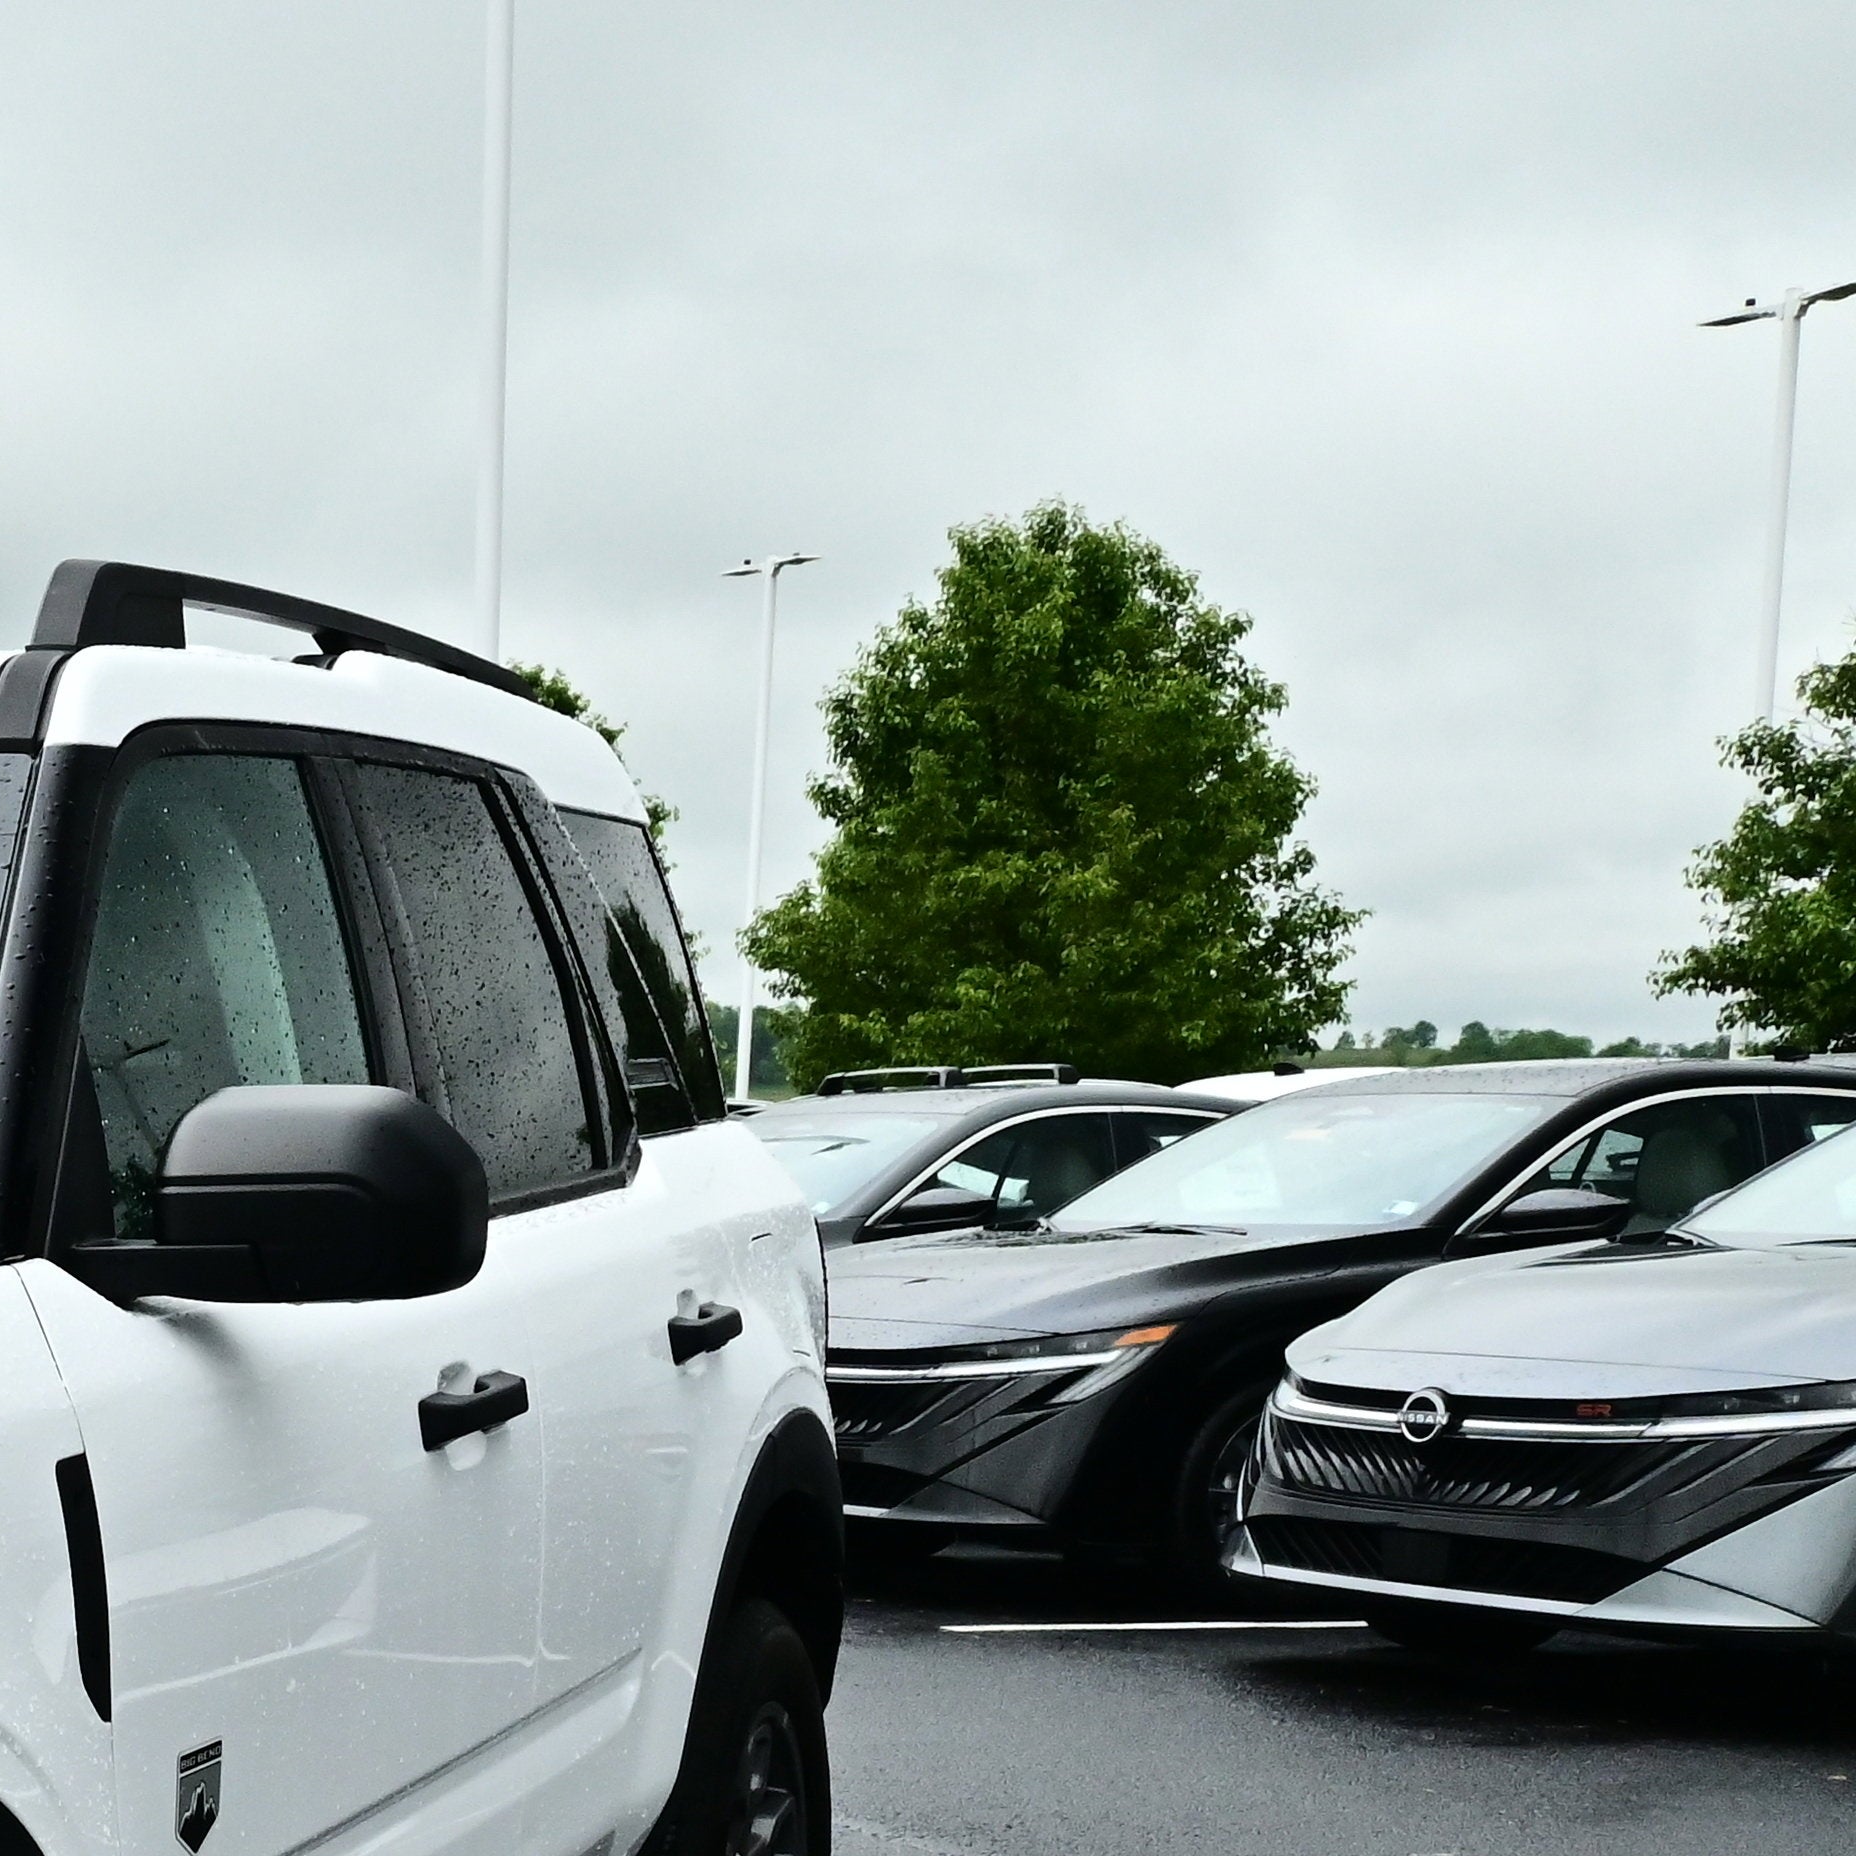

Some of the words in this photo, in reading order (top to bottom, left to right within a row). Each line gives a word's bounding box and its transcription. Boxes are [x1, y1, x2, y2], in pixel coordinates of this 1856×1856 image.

[1397, 1411, 1450, 1424] NISSAN
[1576, 1403, 1613, 1418] SR
[180, 1755, 196, 1770] BIG
[197, 1745, 221, 1763] BEND
